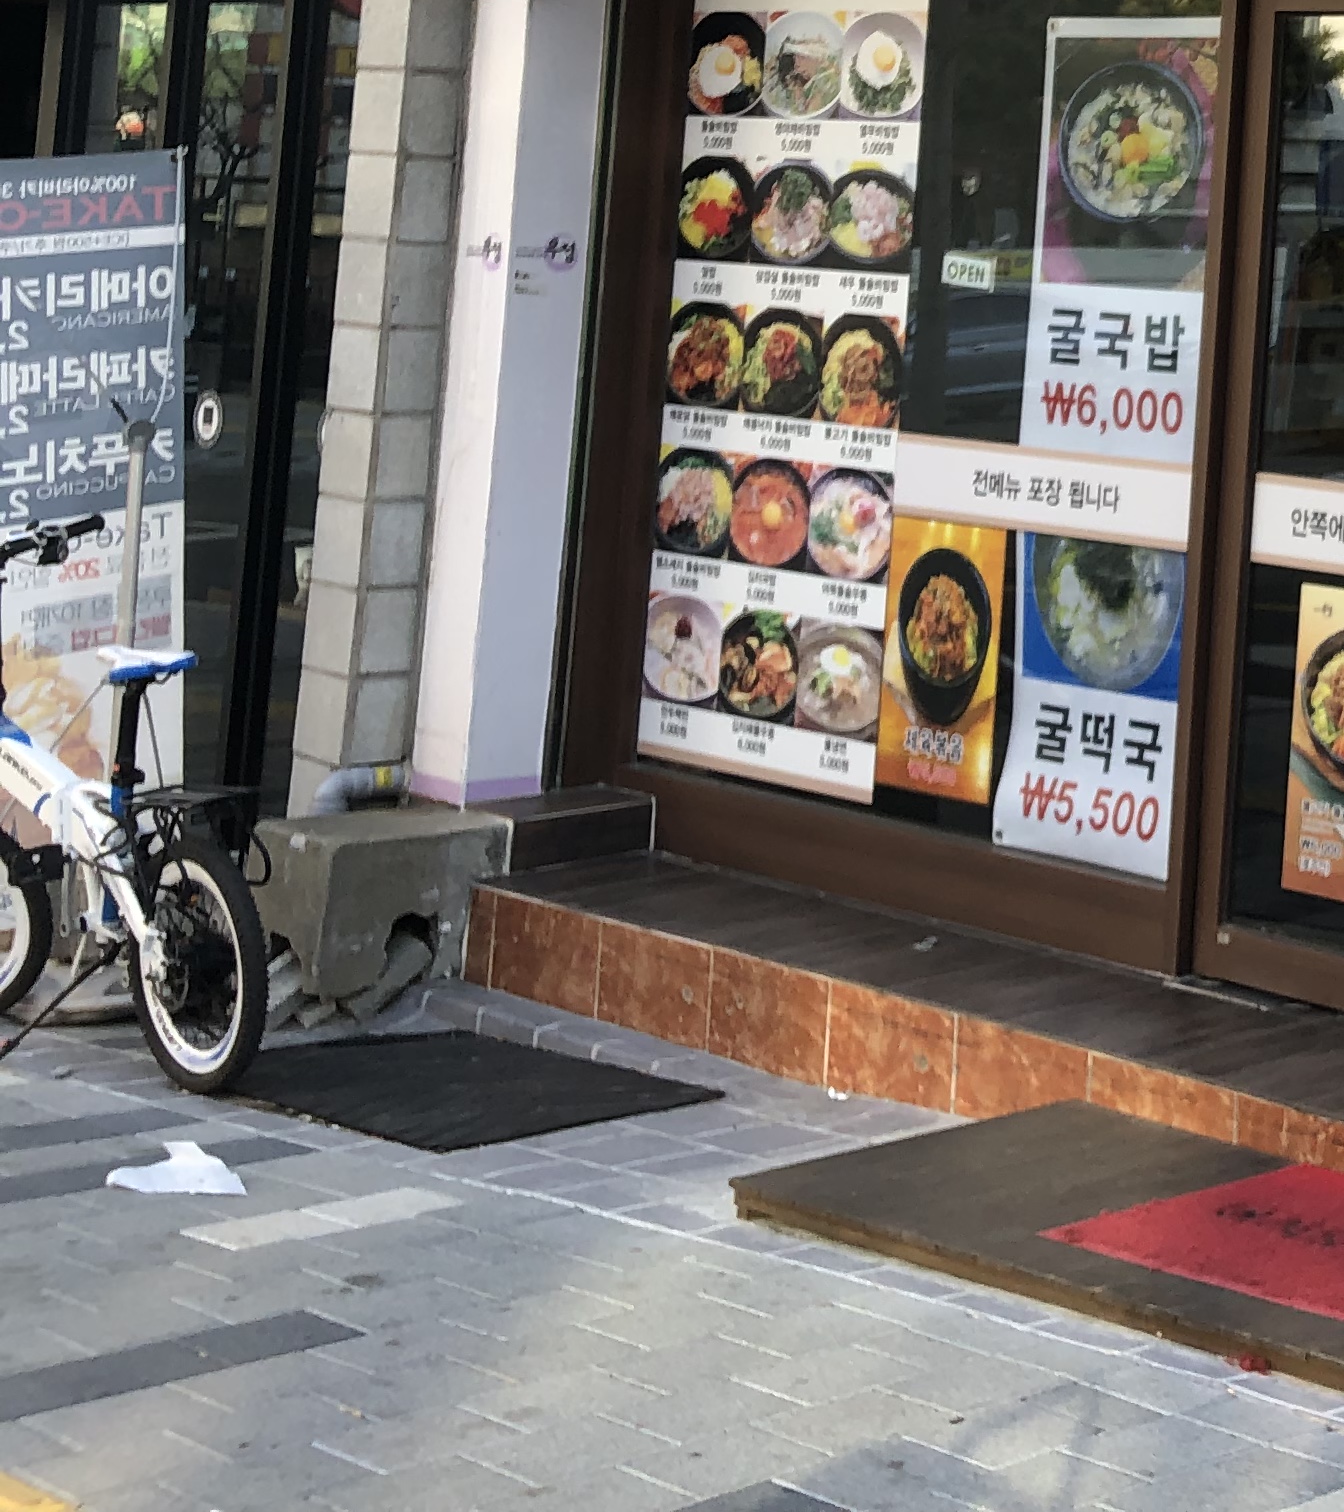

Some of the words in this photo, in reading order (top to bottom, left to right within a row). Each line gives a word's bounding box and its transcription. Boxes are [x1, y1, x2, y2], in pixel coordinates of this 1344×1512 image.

[947, 261, 985, 282] OPEN
[1048, 308, 1185, 374] 굴국밥
[1041, 380, 1183, 435] ₩6,000
[972, 468, 1021, 501] 전메뉴
[1027, 476, 1062, 507] 포장
[1036, 702, 1162, 783] 굴떡국
[1020, 771, 1159, 842] ₩5,500
